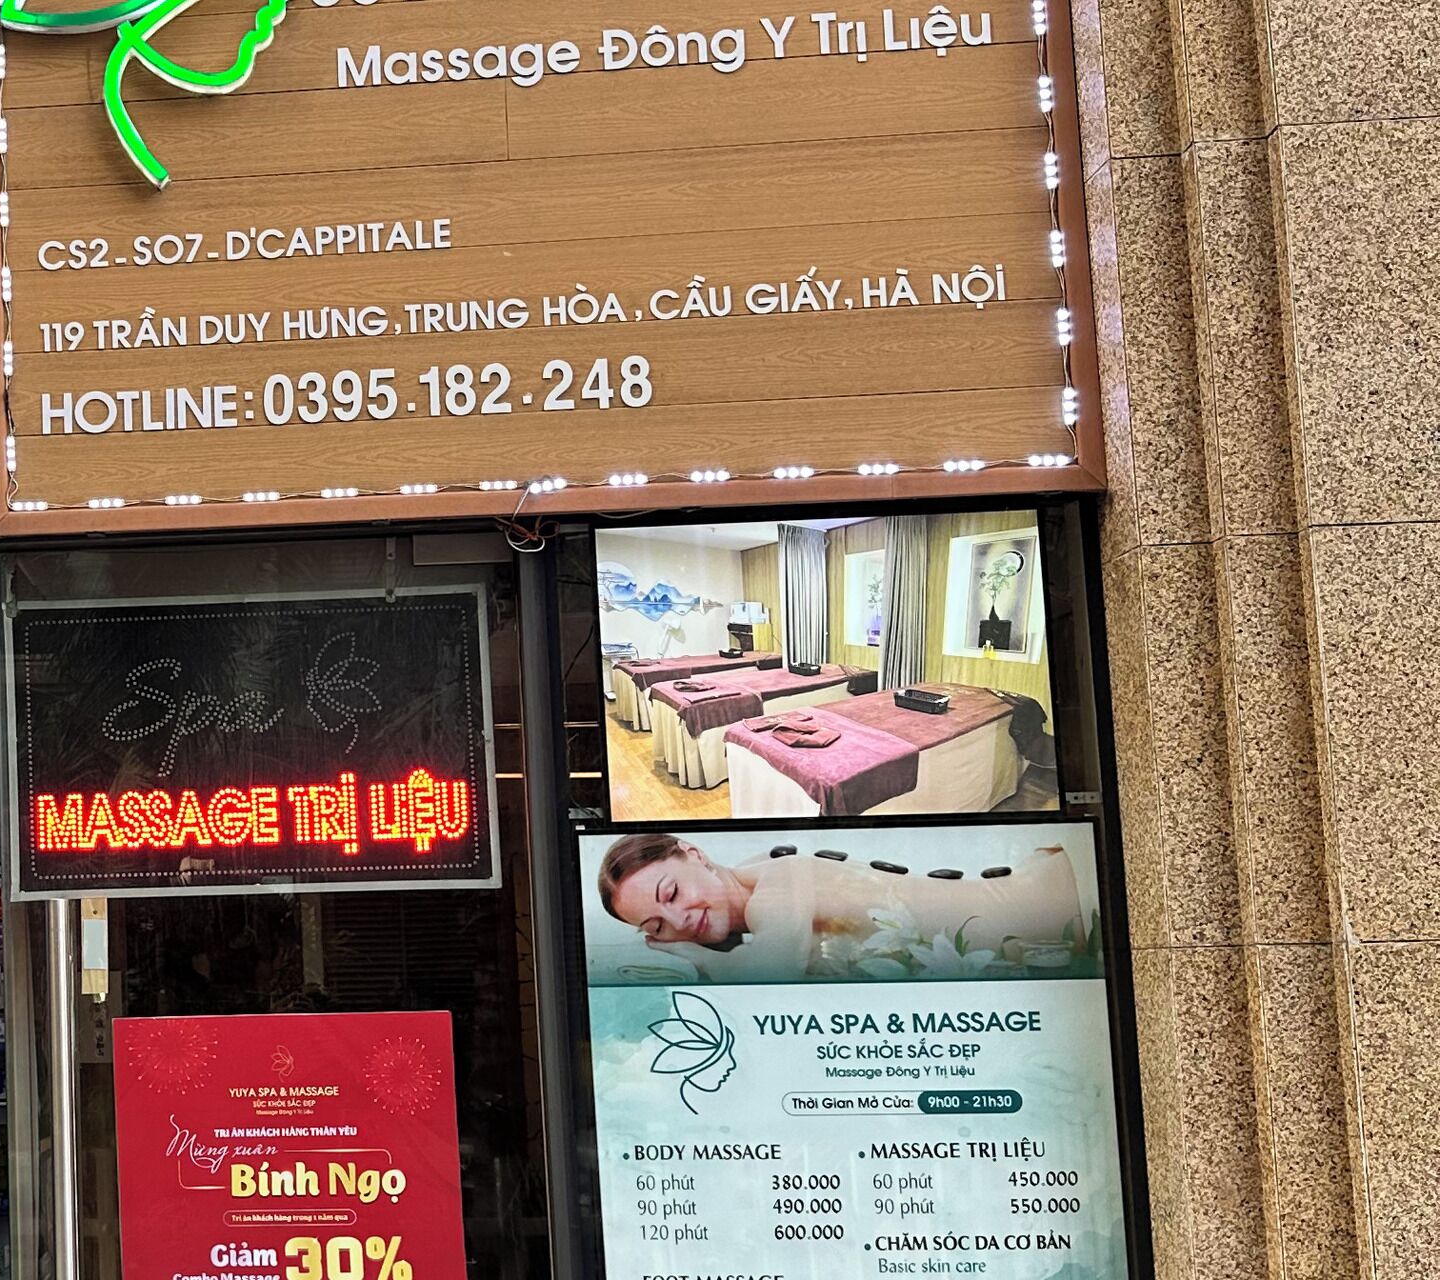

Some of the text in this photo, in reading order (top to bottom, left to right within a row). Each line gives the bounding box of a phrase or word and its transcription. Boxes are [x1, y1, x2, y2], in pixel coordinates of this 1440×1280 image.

[336, 40, 580, 87] Massage
[599, 25, 745, 73] Đông
[760, 17, 795, 58] Y
[810, 11, 867, 61] Trị
[40, 321, 84, 352] 119
[93, 306, 187, 349] TRẦN
[200, 312, 270, 345] DUY
[650, 275, 732, 320] CẦU
[863, 268, 919, 308] HÀ
[933, 264, 1005, 309] NỘI
[102, 658, 284, 777] Spa
[37, 768, 469, 855] MASSAGE TRỊ LIỆU
[752, 1011, 1041, 1035] YUYA SPA & MASSAGE
[817, 1038, 980, 1061] SỨC KHỎE SẮC ĐẸP
[229, 1086, 339, 1098] YUYA SPA & MASSAGE
[792, 1096, 818, 1110] Thời
[822, 1096, 852, 1109] Gian
[858, 1095, 879, 1108] Mở
[928, 1096, 959, 1108] 9h00
[972, 1095, 1012, 1108] 21h30
[634, 1144, 781, 1160] BODY MASSAGE
[871, 1137, 1045, 1161] MASSAGE TRỊ LIỆU
[230, 1162, 406, 1203] Bính Ngọ
[636, 1174, 840, 1195] 60 phút 380.000
[1008, 1171, 1078, 1186] 450.000
[773, 1199, 842, 1214] 490.000
[1011, 1198, 1080, 1214] 550.000
[640, 1224, 844, 1245] 120 phút 600.000
[875, 1230, 1071, 1250] CHĂM SÓC DA CƠ BẢN
[210, 1241, 277, 1267] Giảm
[879, 1258, 986, 1273] Basic skin care
